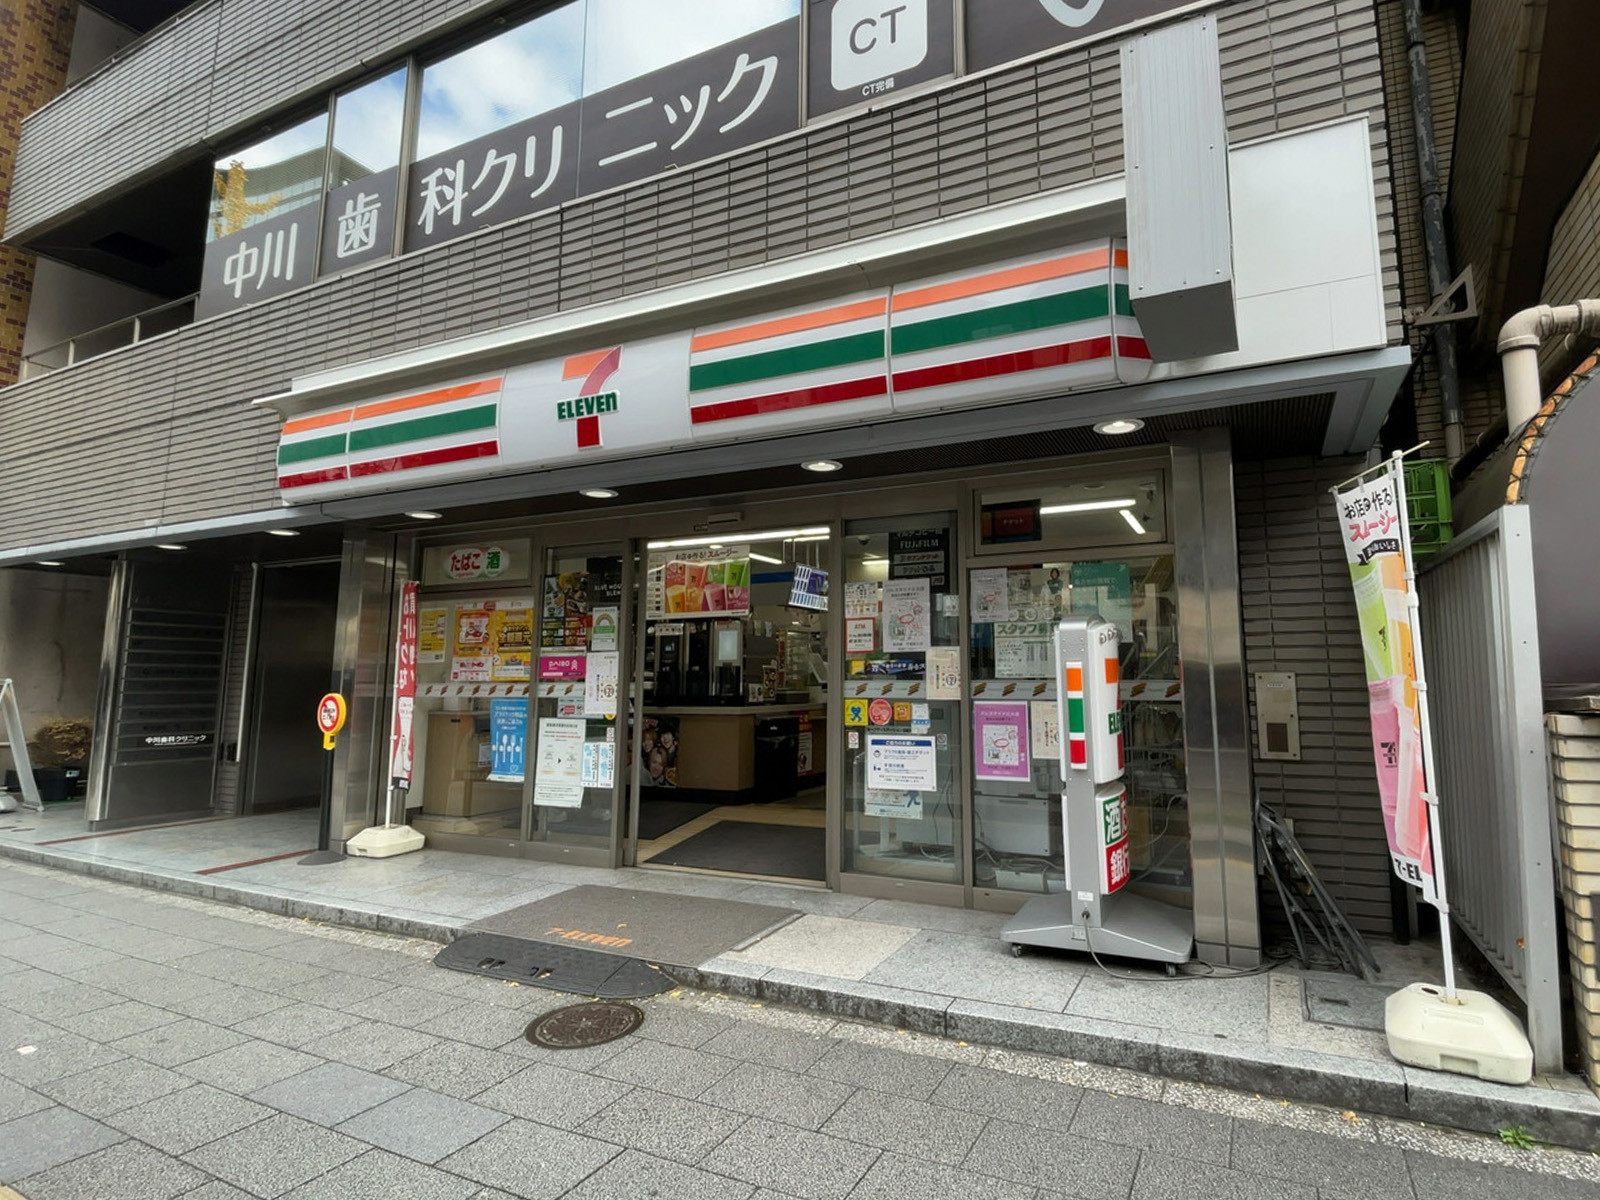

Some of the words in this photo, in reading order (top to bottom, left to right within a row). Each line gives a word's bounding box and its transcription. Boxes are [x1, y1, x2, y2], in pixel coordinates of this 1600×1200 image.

[849, 5, 908, 56] CT
[222, 52, 779, 299] 中川歯科クリニック
[450, 552, 481, 572] たばこ
[486, 551, 501, 569] 酒
[1105, 802, 1121, 843] 酒
